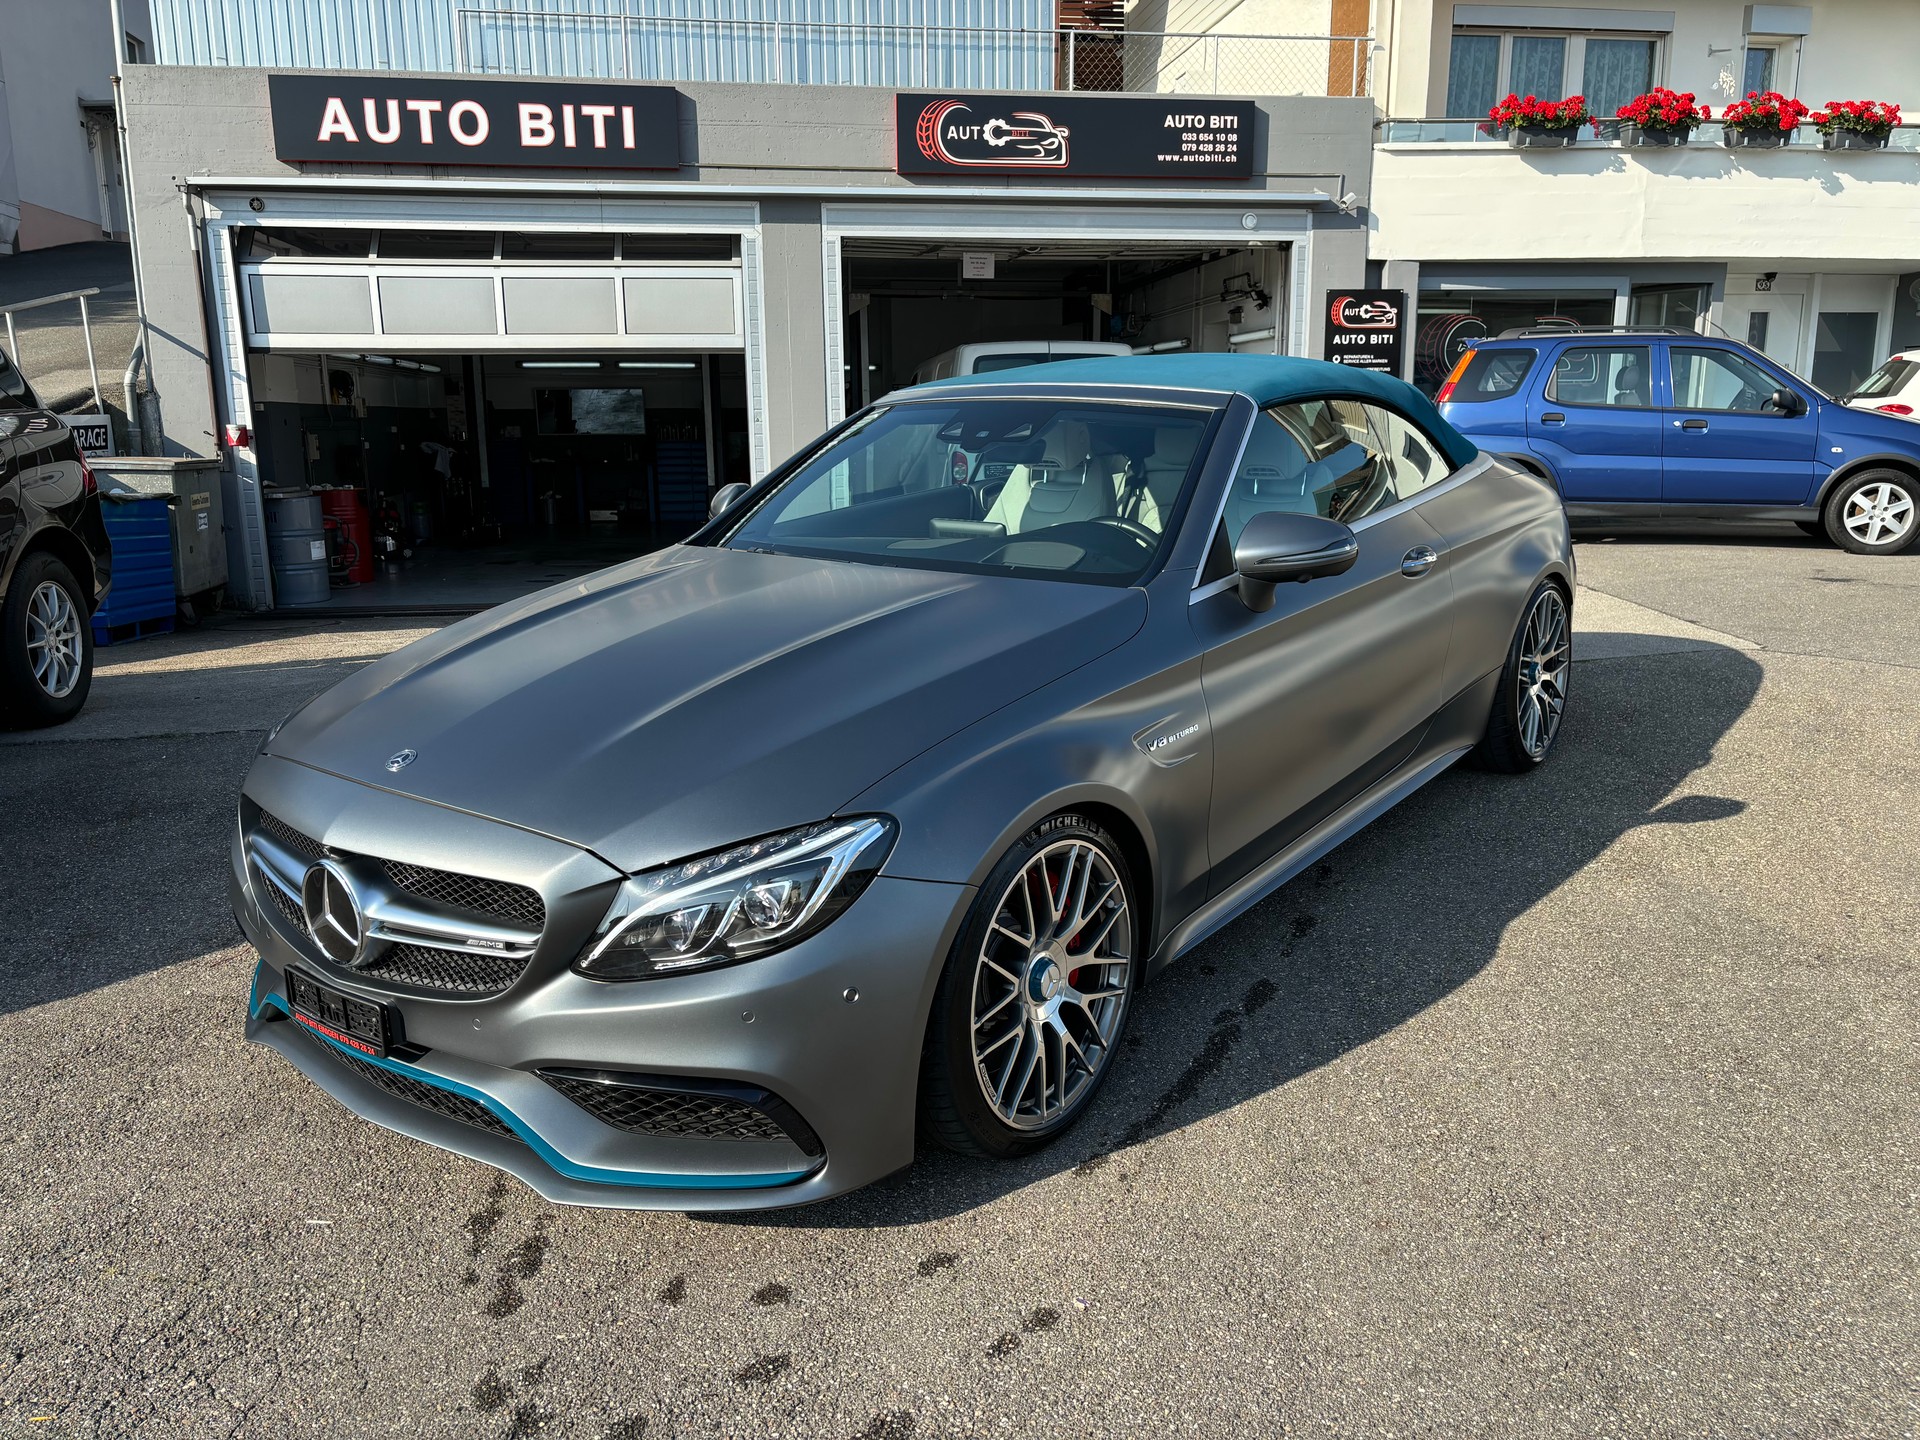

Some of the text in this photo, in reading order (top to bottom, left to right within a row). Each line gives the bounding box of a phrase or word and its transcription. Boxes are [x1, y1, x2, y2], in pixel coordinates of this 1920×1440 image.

[317, 97, 636, 149] AUTO BITI
[1163, 114, 1238, 129] AUTO BITI
[1181, 132, 1238, 142] 033 654 10 08
[1181, 143, 1237, 152] 079 428 26 24
[1157, 154, 1237, 163] www.autobiti.ch
[1333, 335, 1393, 344] AUTO BITI
[73, 428, 106, 447] ARAGE
[1168, 724, 1199, 743] BITURBO
[1040, 816, 1098, 835] MICHELIN
